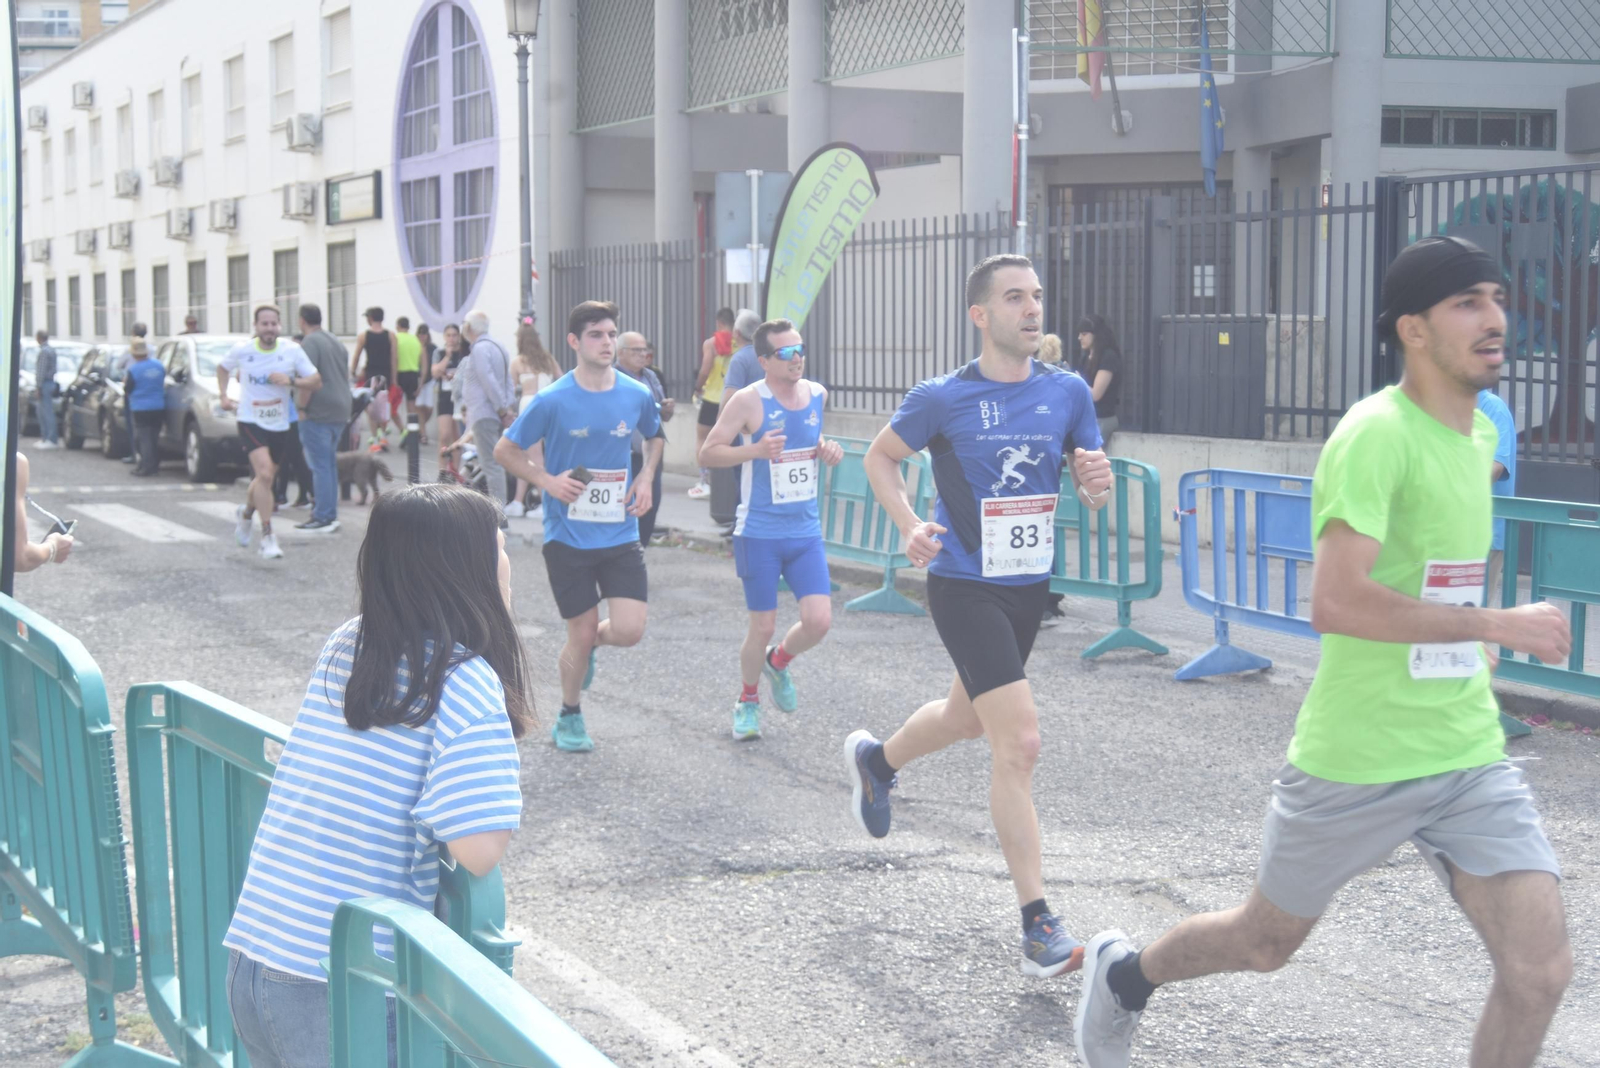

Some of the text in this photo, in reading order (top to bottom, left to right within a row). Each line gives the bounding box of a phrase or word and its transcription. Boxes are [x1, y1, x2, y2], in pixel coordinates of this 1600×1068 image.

[259, 408, 277, 418] 240
[788, 467, 808, 484] 65
[589, 488, 610, 505] 80
[995, 502, 1017, 510] CARRERA
[1010, 524, 1039, 549] 83
